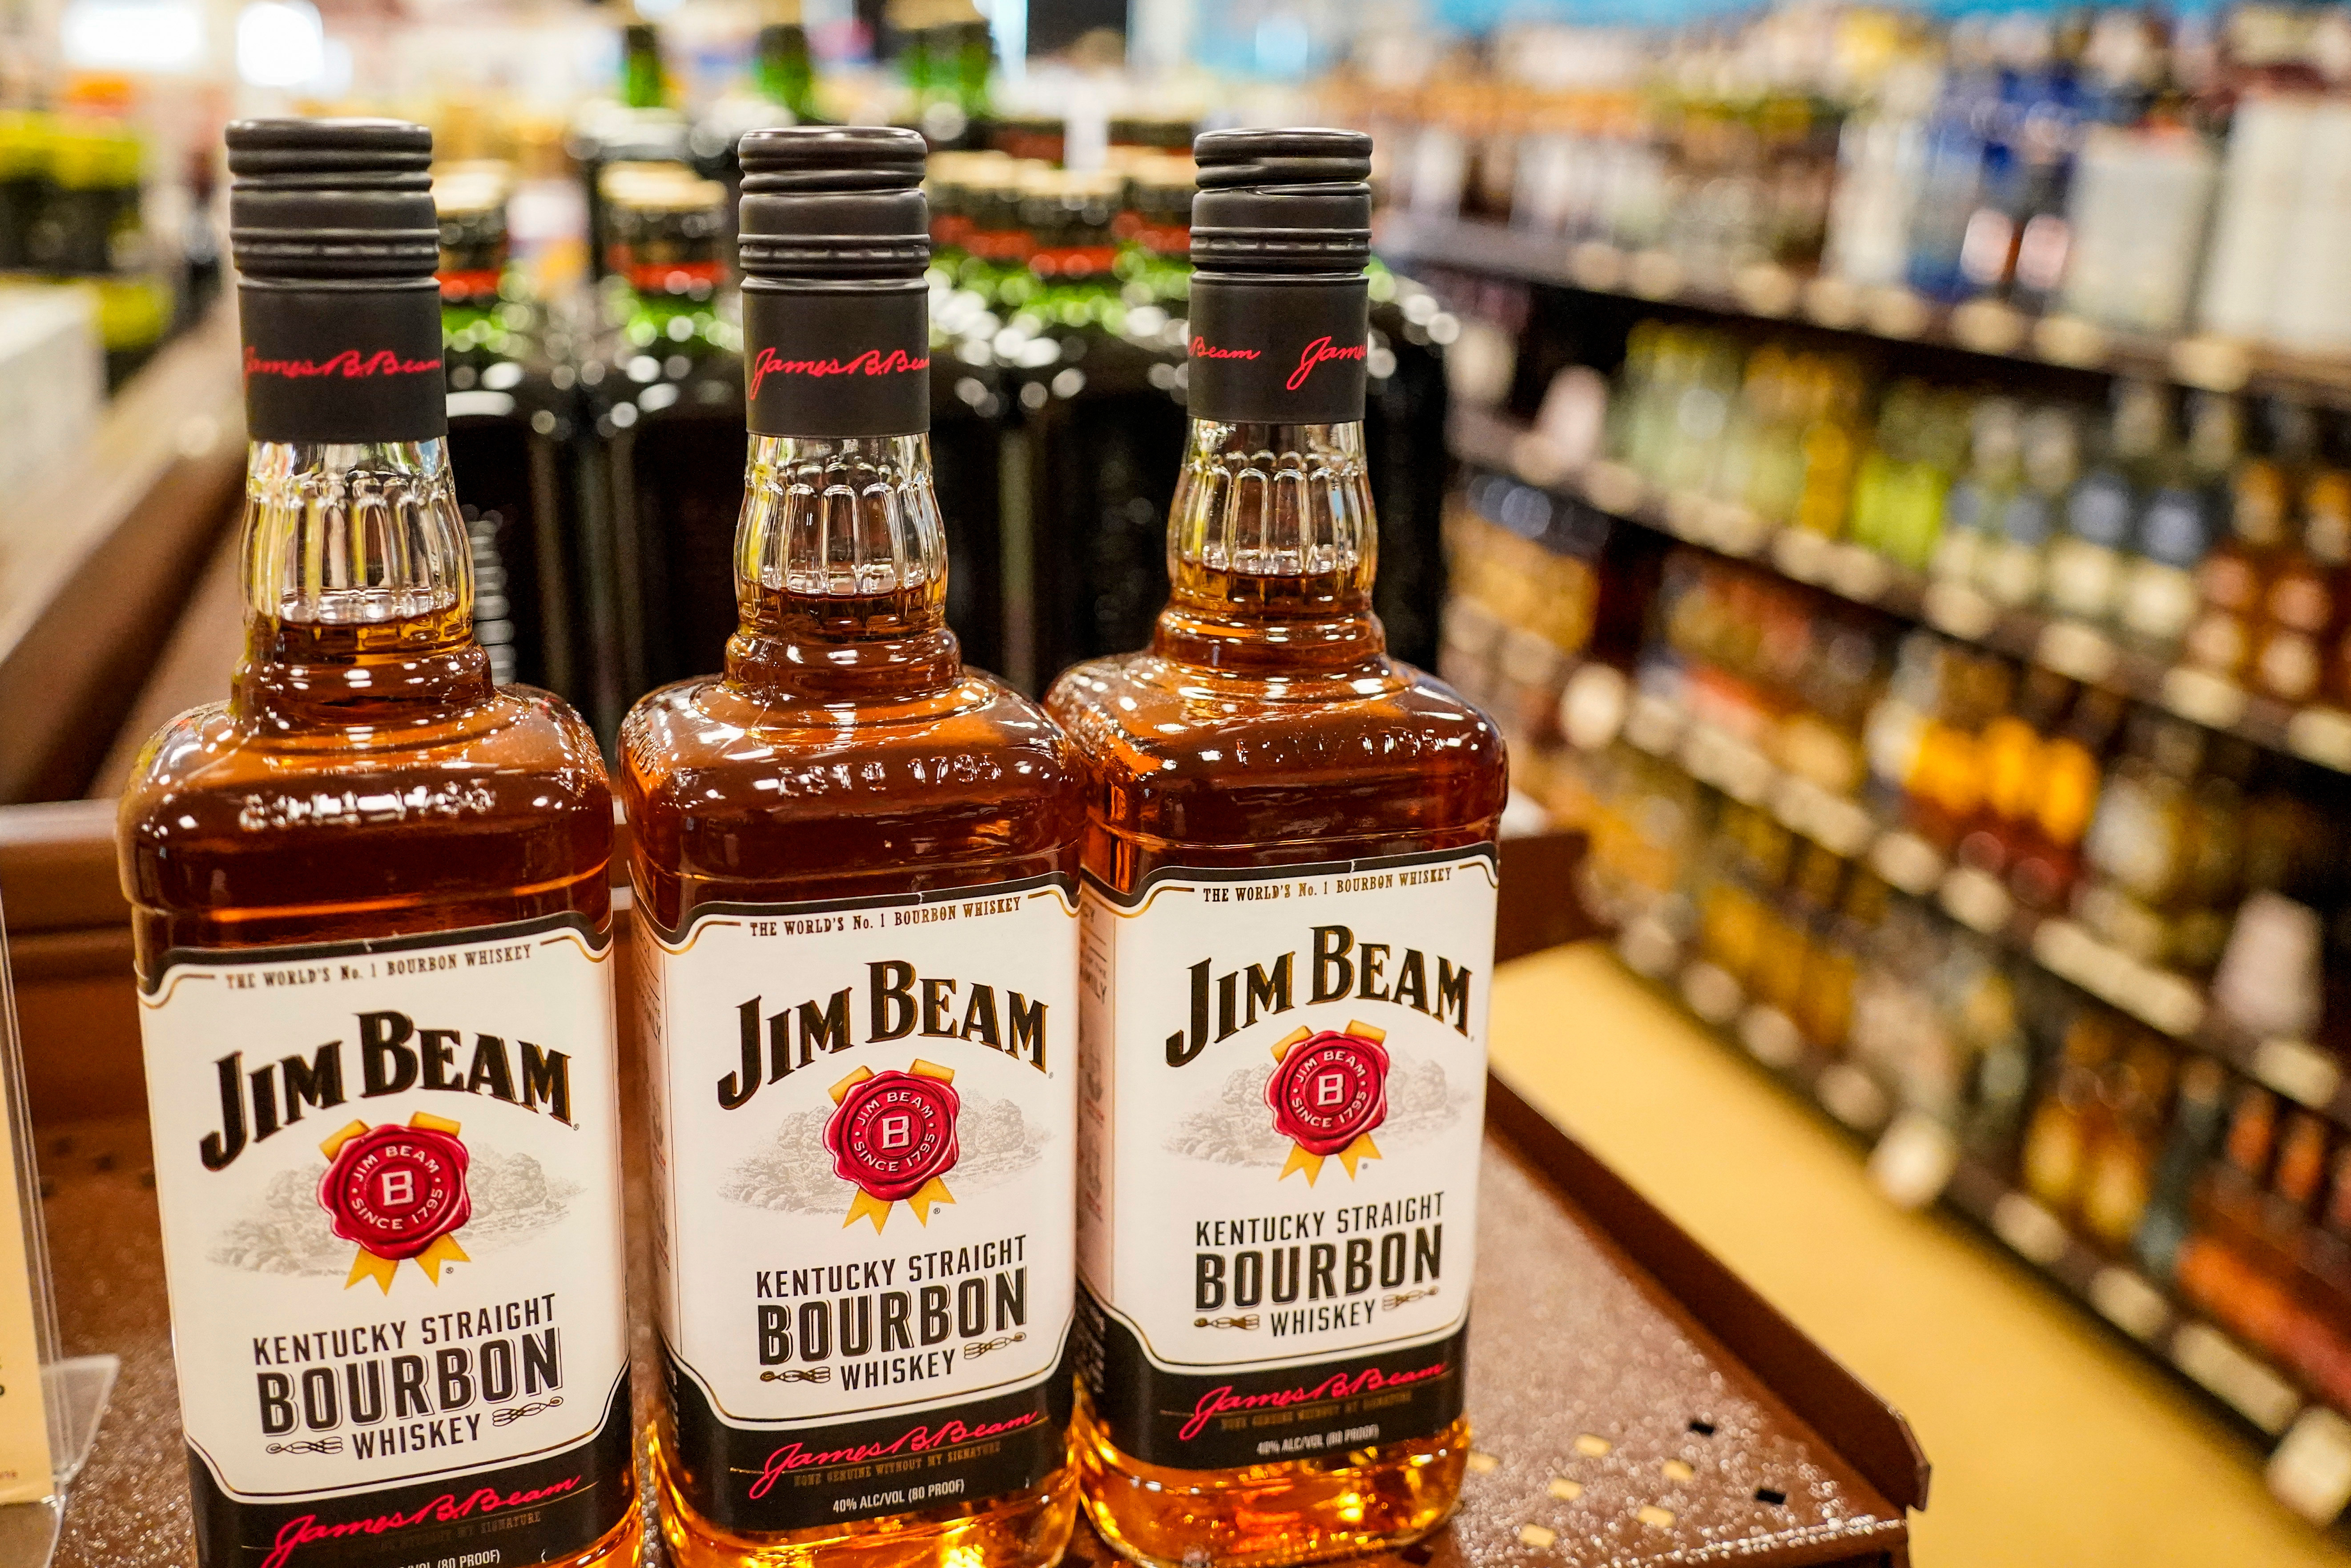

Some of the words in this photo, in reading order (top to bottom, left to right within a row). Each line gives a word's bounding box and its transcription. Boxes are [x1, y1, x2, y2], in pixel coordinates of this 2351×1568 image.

[750, 347, 845, 400] James
[1203, 887, 1229, 902] THE
[1235, 884, 1291, 901] WORLD'S
[1298, 882, 1318, 897] No.
[1323, 882, 1328, 895] 1
[1336, 874, 1393, 894] BOURBON
[1399, 868, 1452, 886] WHISKEY
[750, 922, 777, 937] THE
[785, 917, 844, 935] WORLD'S
[853, 916, 874, 930] No.
[880, 914, 885, 927] 1
[894, 905, 956, 926] BOURBON
[963, 897, 1021, 917] WHISKEY
[226, 973, 255, 990] THE
[263, 968, 330, 987] WORLD'S
[341, 965, 364, 980] No.
[370, 962, 377, 977] 1
[387, 955, 458, 976] BOURBON
[466, 944, 532, 968] WHISKEY
[1165, 950, 1296, 1068] JIM
[1305, 924, 1473, 1038] BEAM
[717, 986, 854, 1110] JIM
[864, 959, 1049, 1074] BEAM
[1296, 1057, 1318, 1083] JIM
[1324, 1051, 1366, 1078] BEAM
[200, 1039, 348, 1172] JIM
[352, 1009, 572, 1127] BEAM
[857, 1100, 880, 1126] JIM
[887, 1092, 934, 1119] BEAM
[1292, 1098, 1332, 1128] SINCE
[1338, 1091, 1367, 1123] 1795
[1317, 1073, 1344, 1106] B
[854, 1141, 899, 1171] SINCE
[906, 1133, 935, 1167] 1795
[882, 1115, 909, 1149] B
[353, 1154, 378, 1182] JIM
[385, 1146, 440, 1174] BEAM
[351, 1198, 403, 1230] SINCE
[411, 1188, 443, 1224] 1795
[381, 1170, 414, 1206] B
[1195, 1211, 1326, 1246] KENTUCKY
[1337, 1190, 1445, 1234] STRAIGHT
[757, 1258, 896, 1299] KENTUCKY
[909, 1234, 1027, 1282] STRAIGHT
[1195, 1222, 1443, 1312] BOURBON
[254, 1320, 407, 1366] KENTUCKY
[422, 1293, 556, 1343] STRAIGHT
[757, 1265, 1027, 1365] BOURBON
[1270, 1298, 1377, 1337] WHISKEY
[257, 1326, 563, 1436] BOURBON
[841, 1348, 956, 1391] WHISKEY
[1178, 1385, 1309, 1441] James
[1352, 1362, 1448, 1394] Beam
[351, 1413, 481, 1460] WHISKEY
[749, 1443, 891, 1500] James
[933, 1411, 1038, 1447] Beam
[833, 1496, 857, 1513] 40%
[859, 1488, 906, 1510] ALC/VOL
[908, 1487, 926, 1504] (80
[927, 1478, 966, 1498] PROOF)
[260, 1514, 410, 1568] James
[462, 1475, 581, 1513] Beam
[459, 1549, 500, 1568] PROOF)
